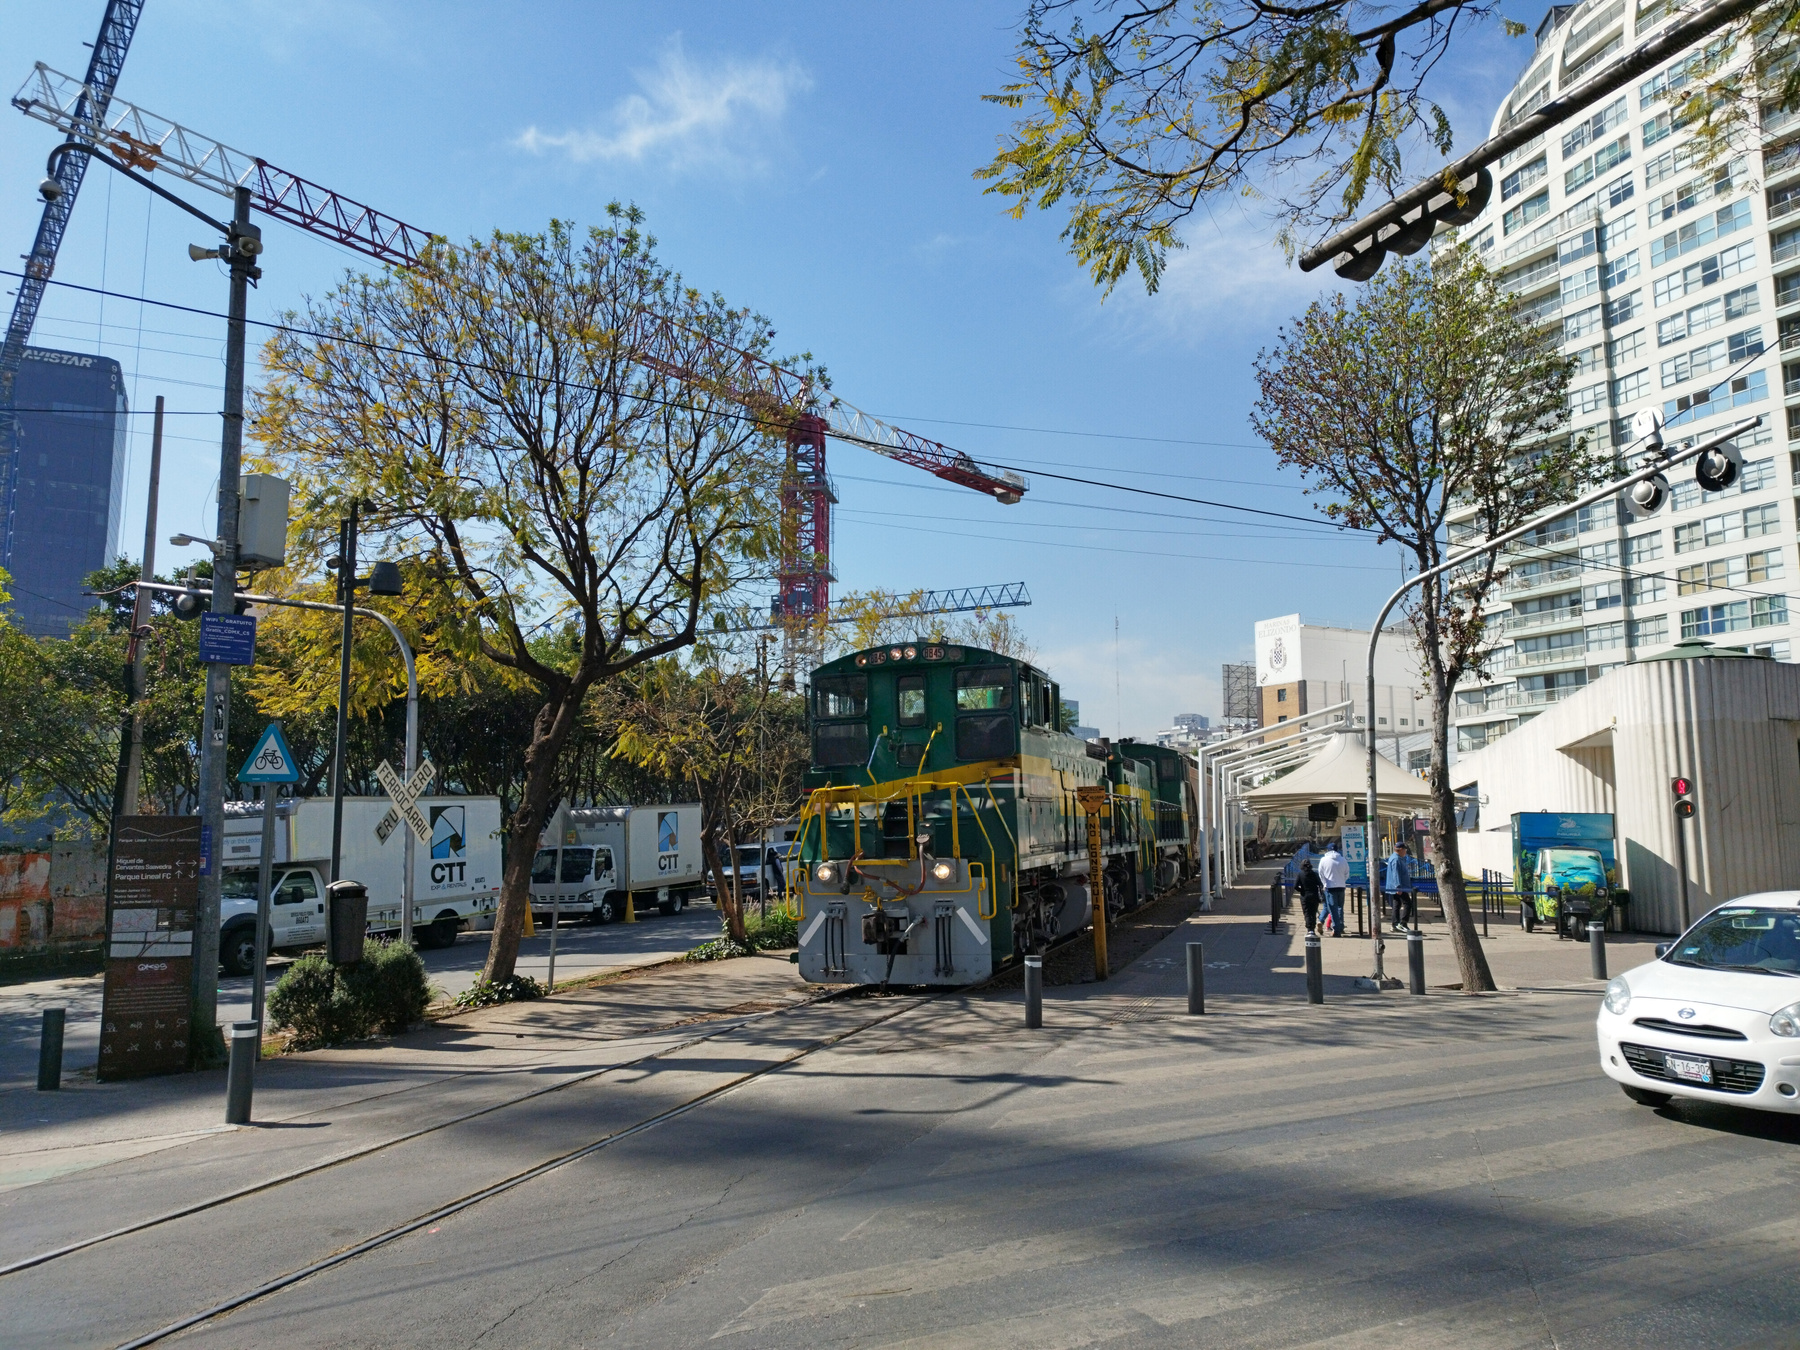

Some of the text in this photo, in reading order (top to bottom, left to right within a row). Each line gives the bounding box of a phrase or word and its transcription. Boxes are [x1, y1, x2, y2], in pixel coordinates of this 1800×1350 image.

[21, 349, 91, 368] AVISTAR
[1258, 625, 1296, 638] ELIZONDO
[1264, 618, 1290, 630] MARINAS
[378, 764, 430, 842] FERROCARRIL
[1089, 823, 1097, 837] NO
[658, 854, 678, 870] CTT
[115, 874, 140, 882] Parque
[430, 862, 466, 884] CTT
[1091, 844, 1100, 911] CONSTRUIR
